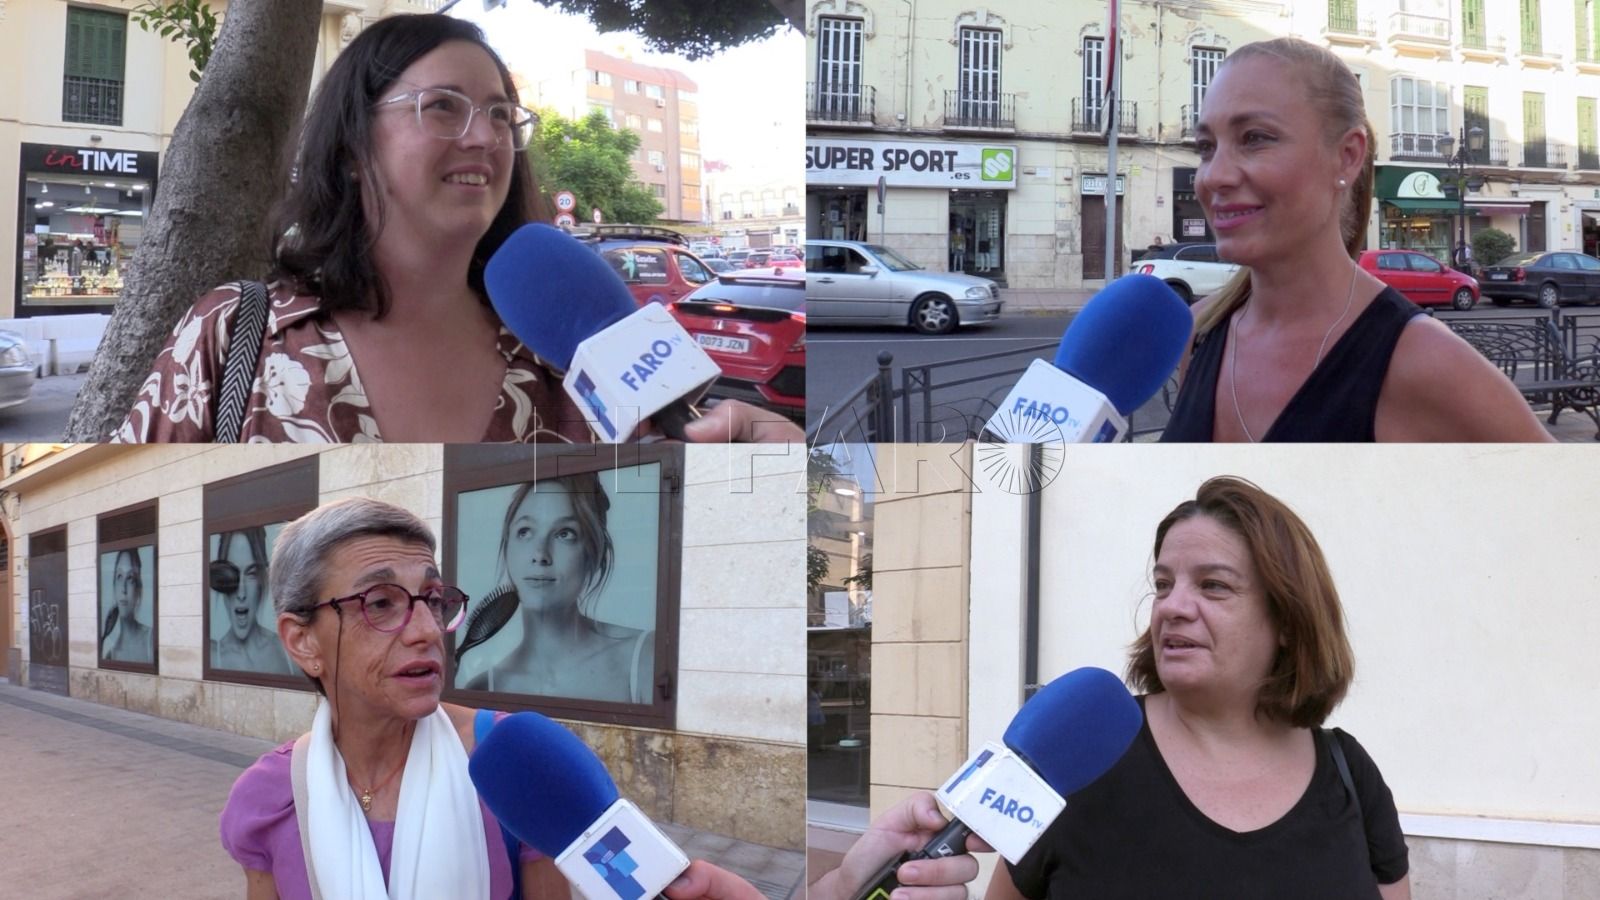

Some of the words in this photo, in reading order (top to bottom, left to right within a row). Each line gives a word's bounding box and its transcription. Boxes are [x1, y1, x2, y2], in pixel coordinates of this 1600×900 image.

[806, 146, 874, 171] SUPER
[882, 148, 958, 172] SPORT
[560, 198, 571, 206] 20
[726, 339, 745, 350] JZN
[620, 339, 673, 392] FARO
[1012, 397, 1069, 425] FARO
[979, 787, 1034, 823] FARO
